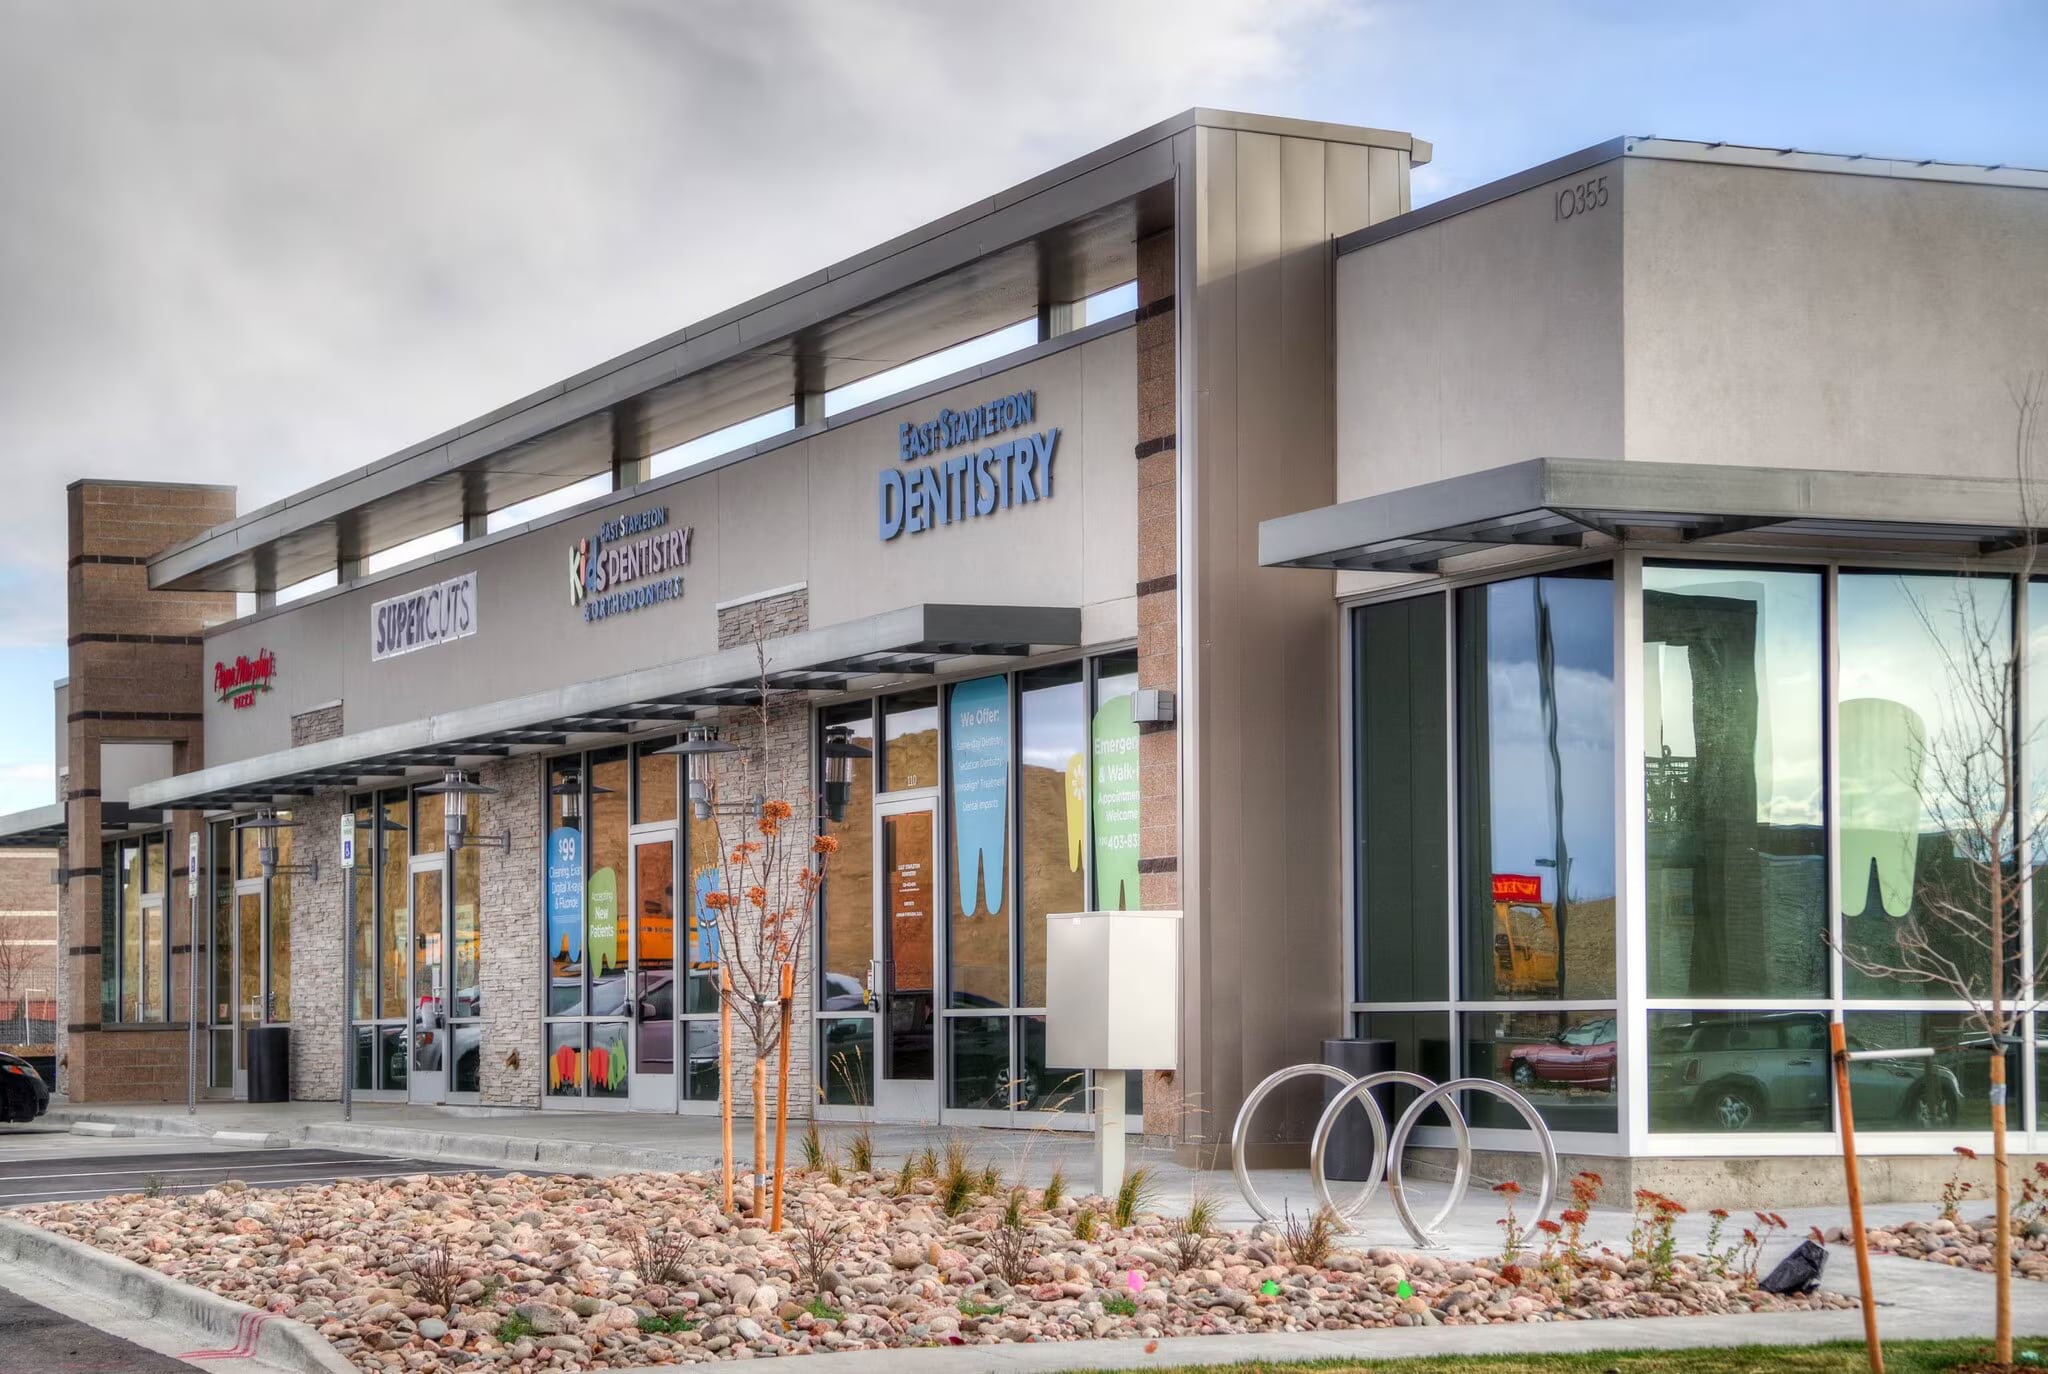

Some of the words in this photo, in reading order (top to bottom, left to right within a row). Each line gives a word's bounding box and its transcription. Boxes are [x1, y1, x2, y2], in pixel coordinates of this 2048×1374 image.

[1555, 176, 1609, 223] 10355
[898, 421, 938, 461] EAST
[938, 389, 1035, 448] STAPLETON
[879, 427, 1060, 541] DENTISTRY
[619, 506, 668, 537] STAPLETON
[376, 579, 471, 654] SUPERCUTS
[960, 711, 975, 727] We
[590, 924, 614, 938] Patients
[595, 907, 609, 920] New
